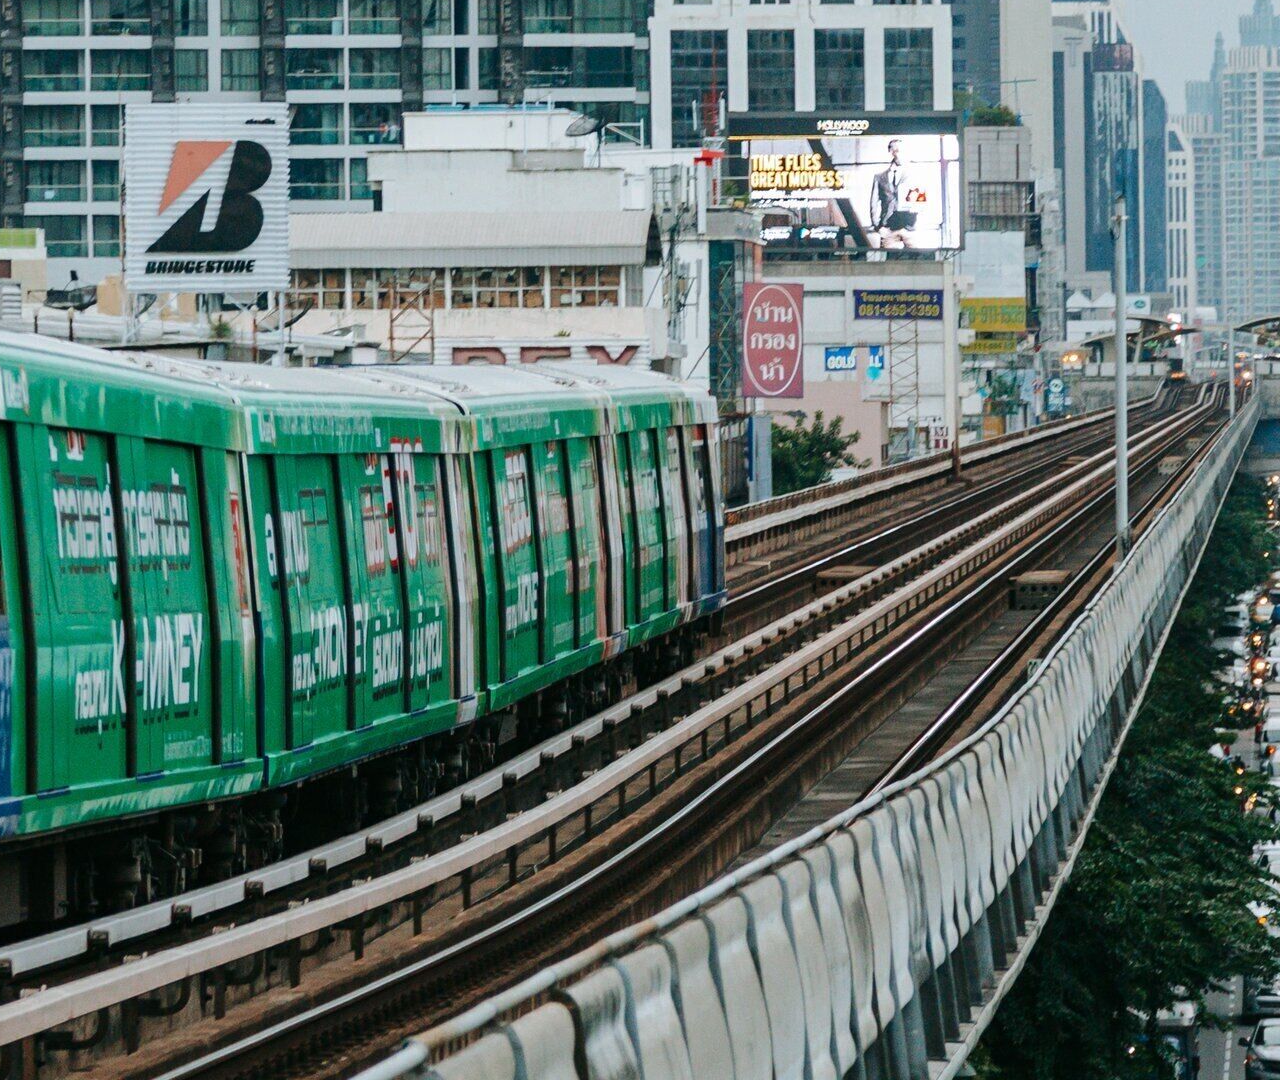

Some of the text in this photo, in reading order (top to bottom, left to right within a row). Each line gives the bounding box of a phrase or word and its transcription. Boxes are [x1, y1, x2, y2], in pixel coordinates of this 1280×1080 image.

[752, 153, 822, 171] TIME FLIES
[750, 170, 788, 189] GREAT
[788, 170, 835, 189] MOVIES
[145, 259, 256, 275] BRIDGESTONE
[753, 300, 793, 323] บ้าน
[750, 331, 796, 350] กรอง
